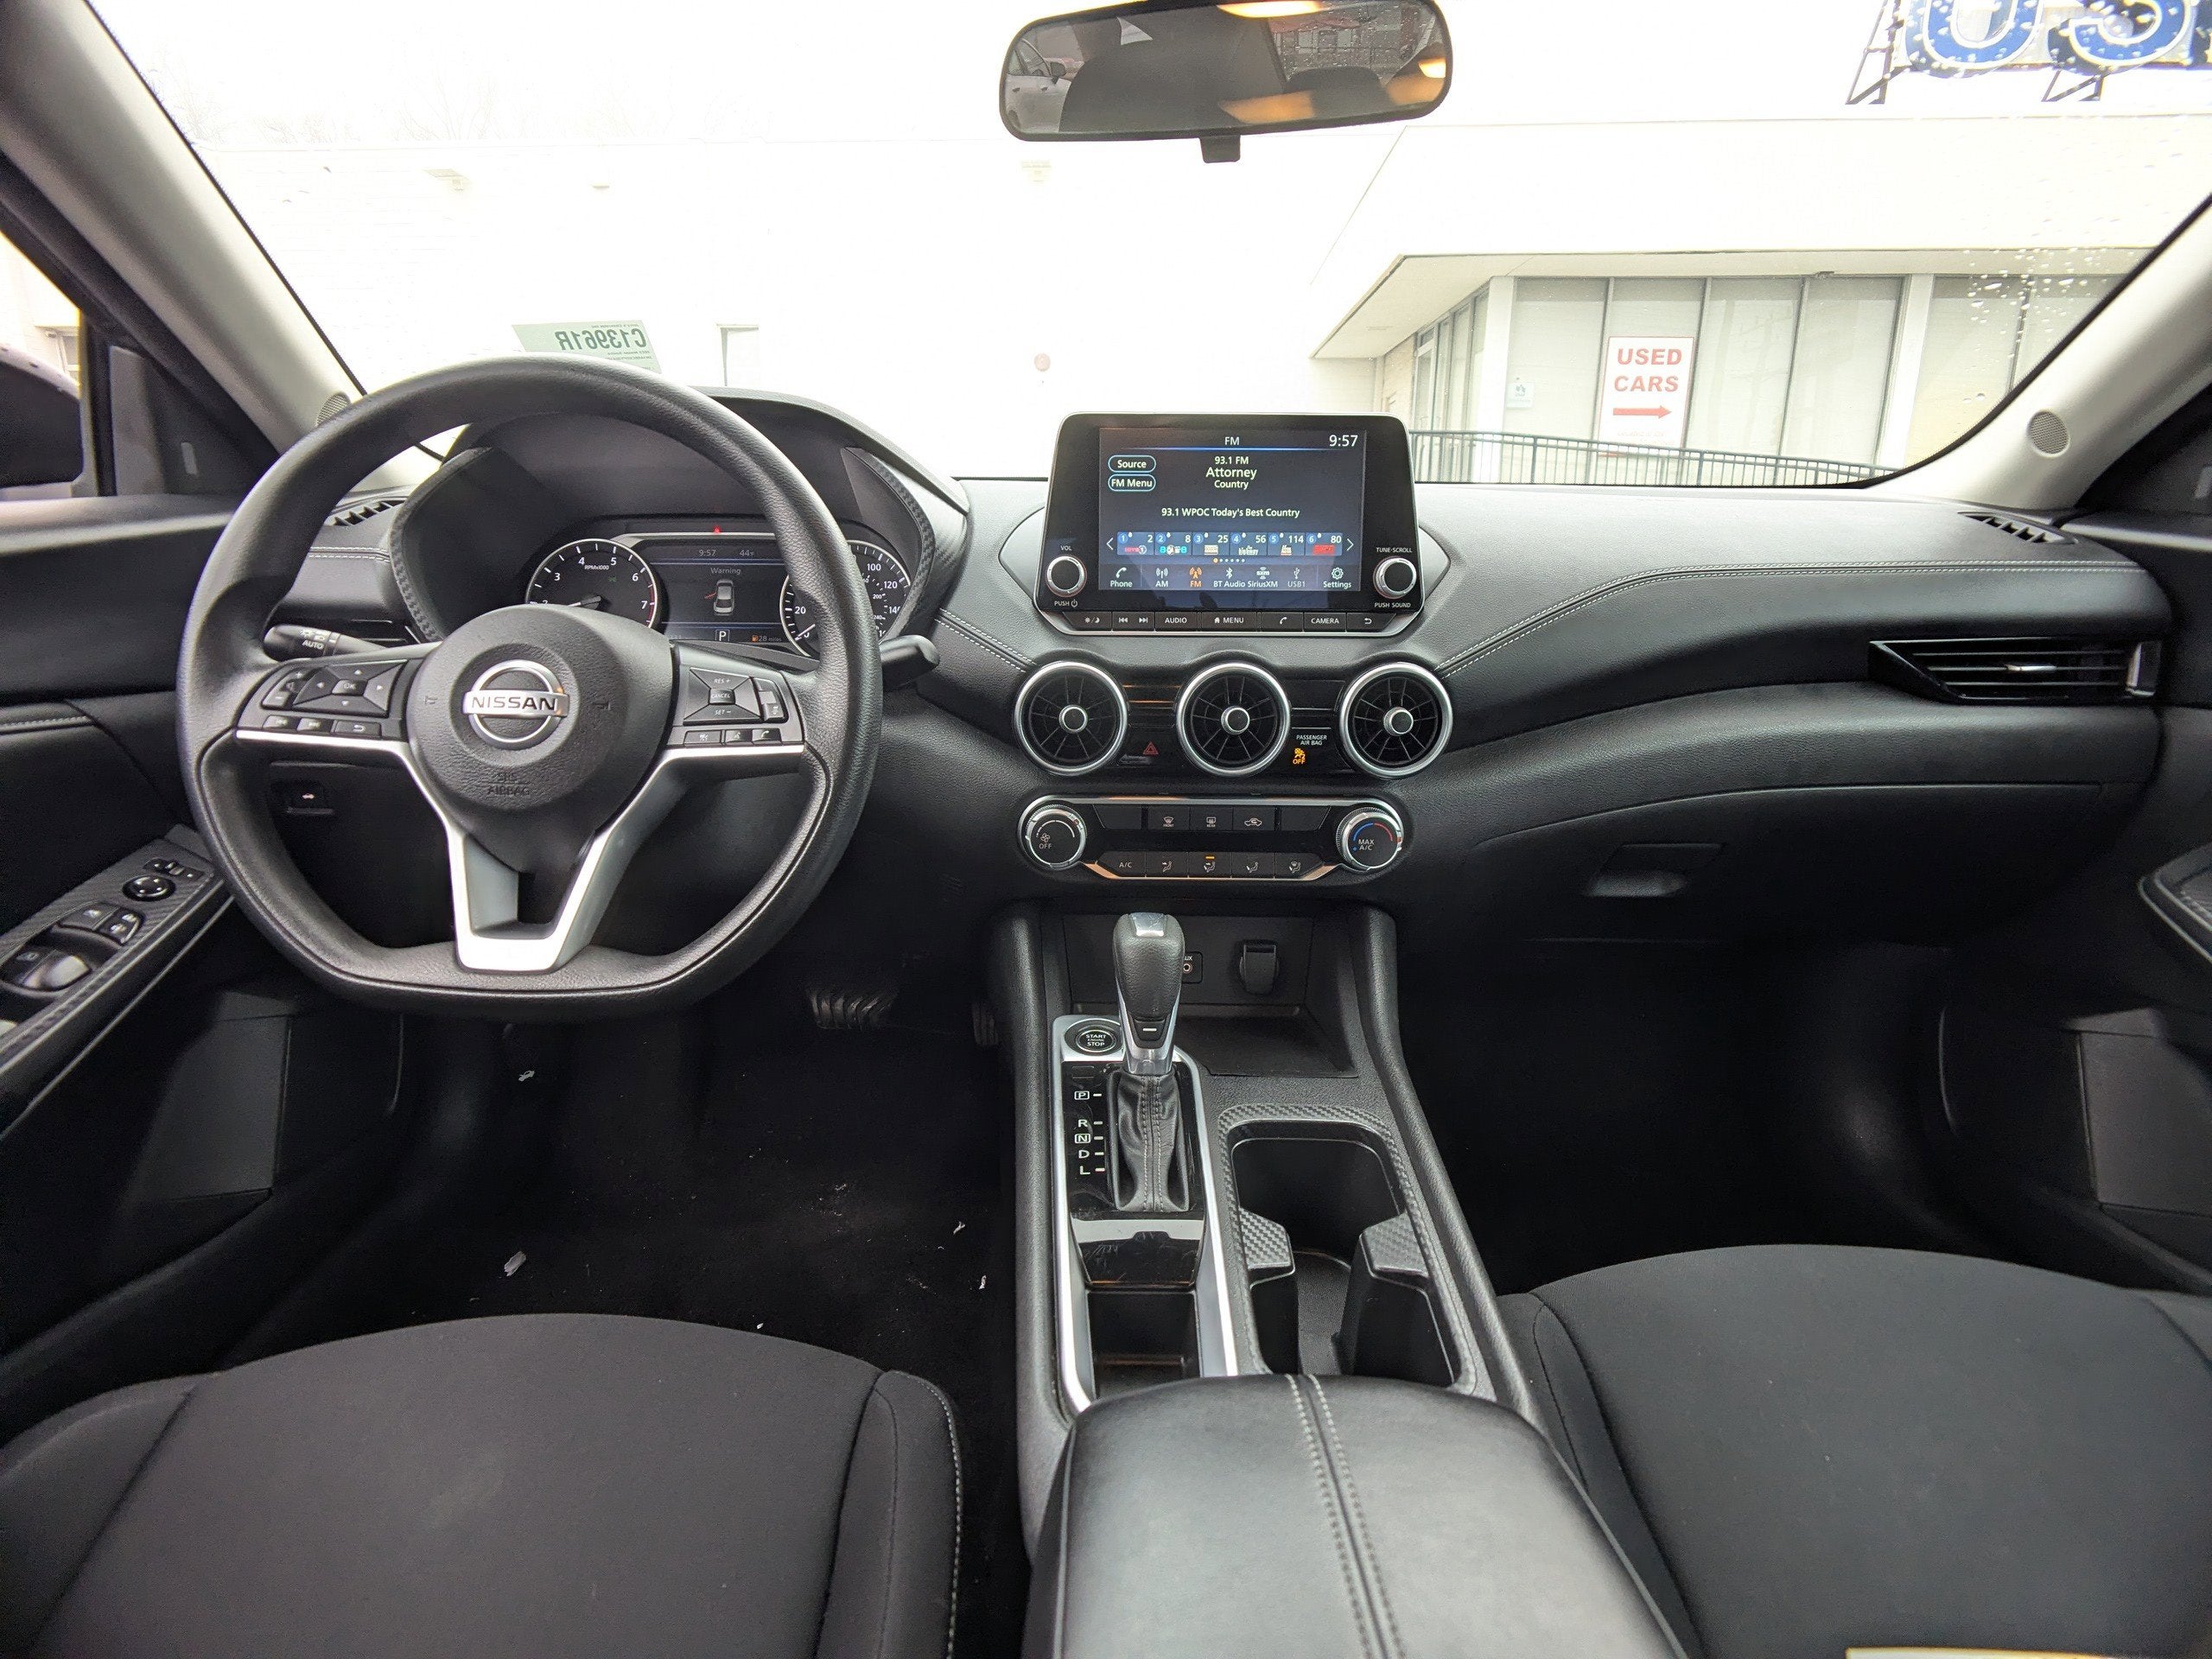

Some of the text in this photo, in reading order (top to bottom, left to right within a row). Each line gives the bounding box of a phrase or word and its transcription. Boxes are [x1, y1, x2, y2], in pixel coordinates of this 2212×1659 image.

[1617, 348, 1682, 365] USED
[1614, 375, 1679, 392] CARS
[1329, 435, 1358, 447] 9:57
[1117, 460, 1147, 468] Source
[1205, 467, 1257, 480] Attorney
[1111, 479, 1153, 487] FM Menu
[1214, 480, 1249, 490] Country
[1161, 508, 1300, 518] 93.1 WPOC Today's Best Country
[1147, 535, 1154, 543] 2
[1185, 535, 1192, 543] 8
[1217, 535, 1229, 543] 25
[1255, 535, 1267, 543] 56
[1288, 535, 1304, 543] 114
[1331, 535, 1342, 543] 80
[554, 573, 561, 582] 3
[632, 573, 639, 582] 6
[884, 581, 898, 589] 120
[1323, 581, 1352, 589] Settings
[641, 600, 648, 609] 7
[794, 606, 806, 614] 20
[718, 630, 727, 641] P
[302, 640, 324, 650] AUTO
[472, 696, 556, 711] NISSAN
[1077, 1119, 1089, 1128] R
[1078, 1149, 1090, 1159] D
[1079, 1165, 1090, 1175] L
